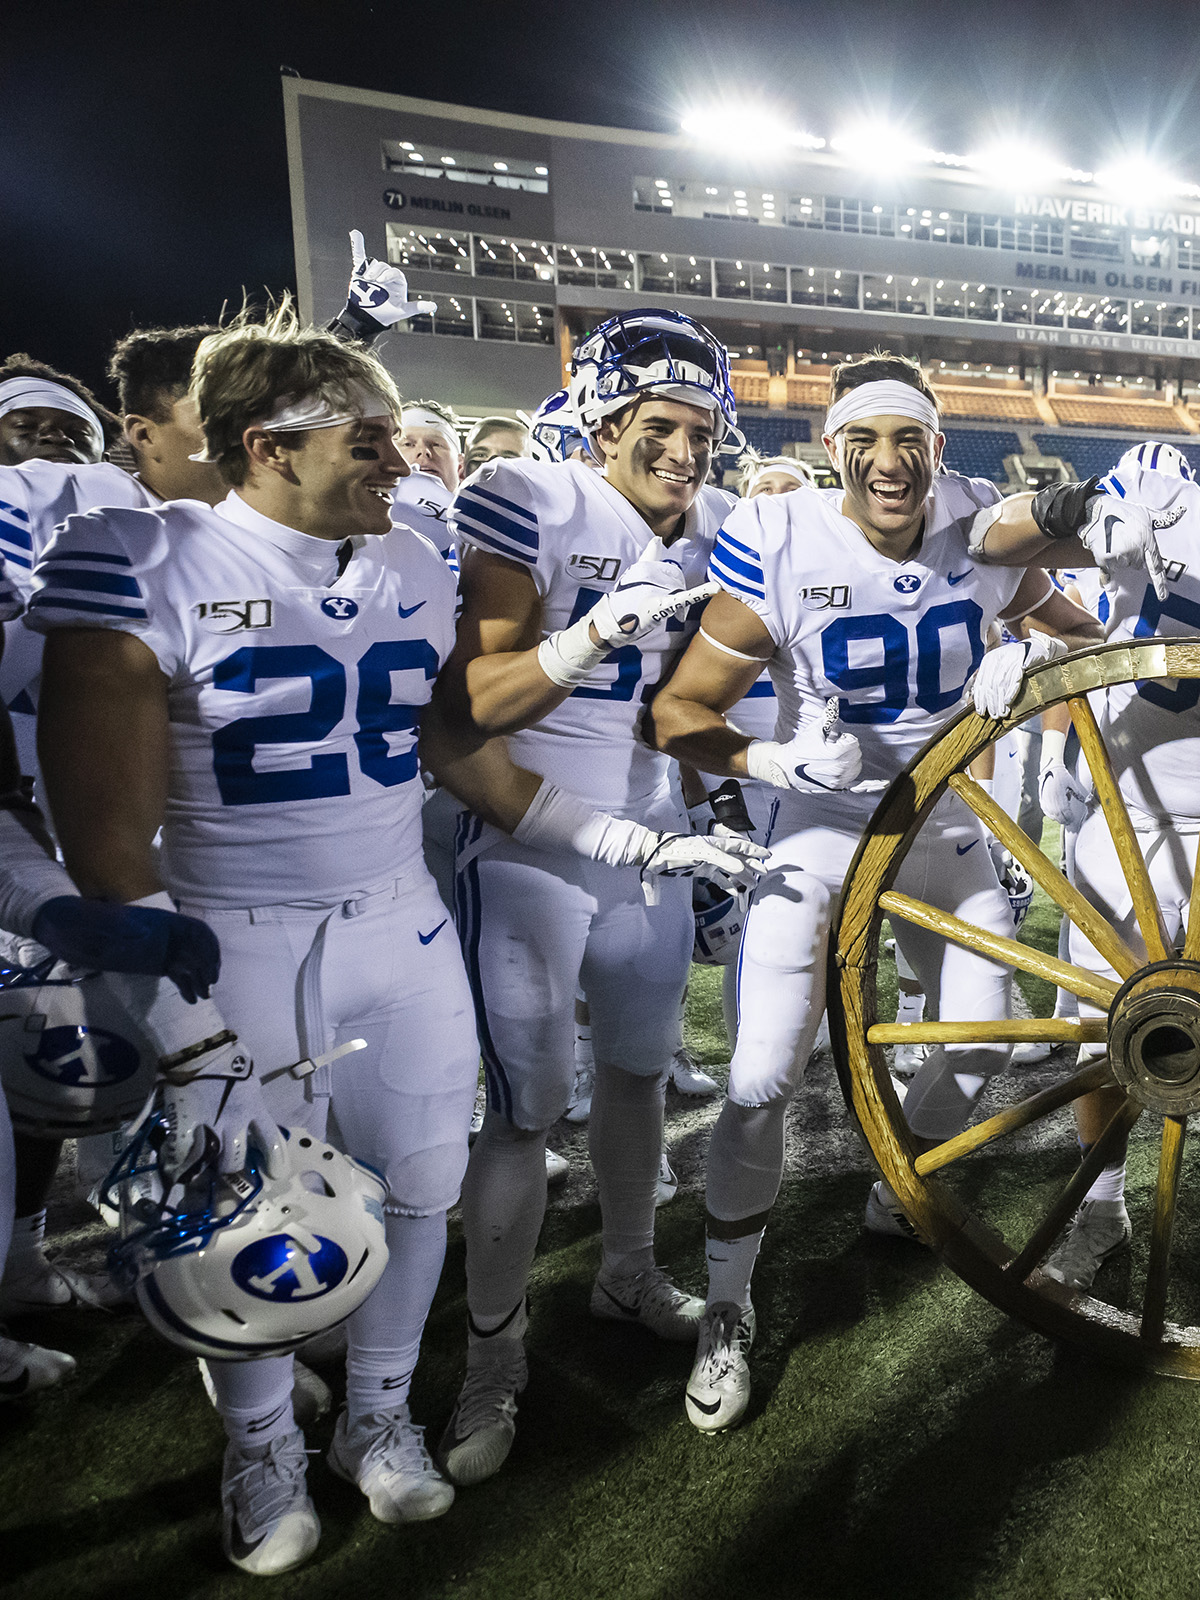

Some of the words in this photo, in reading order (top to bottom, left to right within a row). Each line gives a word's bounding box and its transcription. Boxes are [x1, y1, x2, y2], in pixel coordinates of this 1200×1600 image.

[386, 191, 403, 206] 71
[410, 196, 464, 214] MERLIN
[1015, 195, 1128, 226] MAVERIK
[1016, 262, 1096, 284] MERLIN
[1104, 271, 1172, 293] OLSEN
[1016, 328, 1059, 343] UTAH
[1069, 334, 1121, 348] STATE
[571, 554, 622, 581] 150
[896, 575, 920, 592] Y
[323, 598, 355, 618] Y
[652, 593, 710, 621] COUGARS
[800, 585, 850, 610] 150
[196, 599, 272, 632] 150
[821, 598, 985, 724] 90
[212, 639, 440, 806] 26
